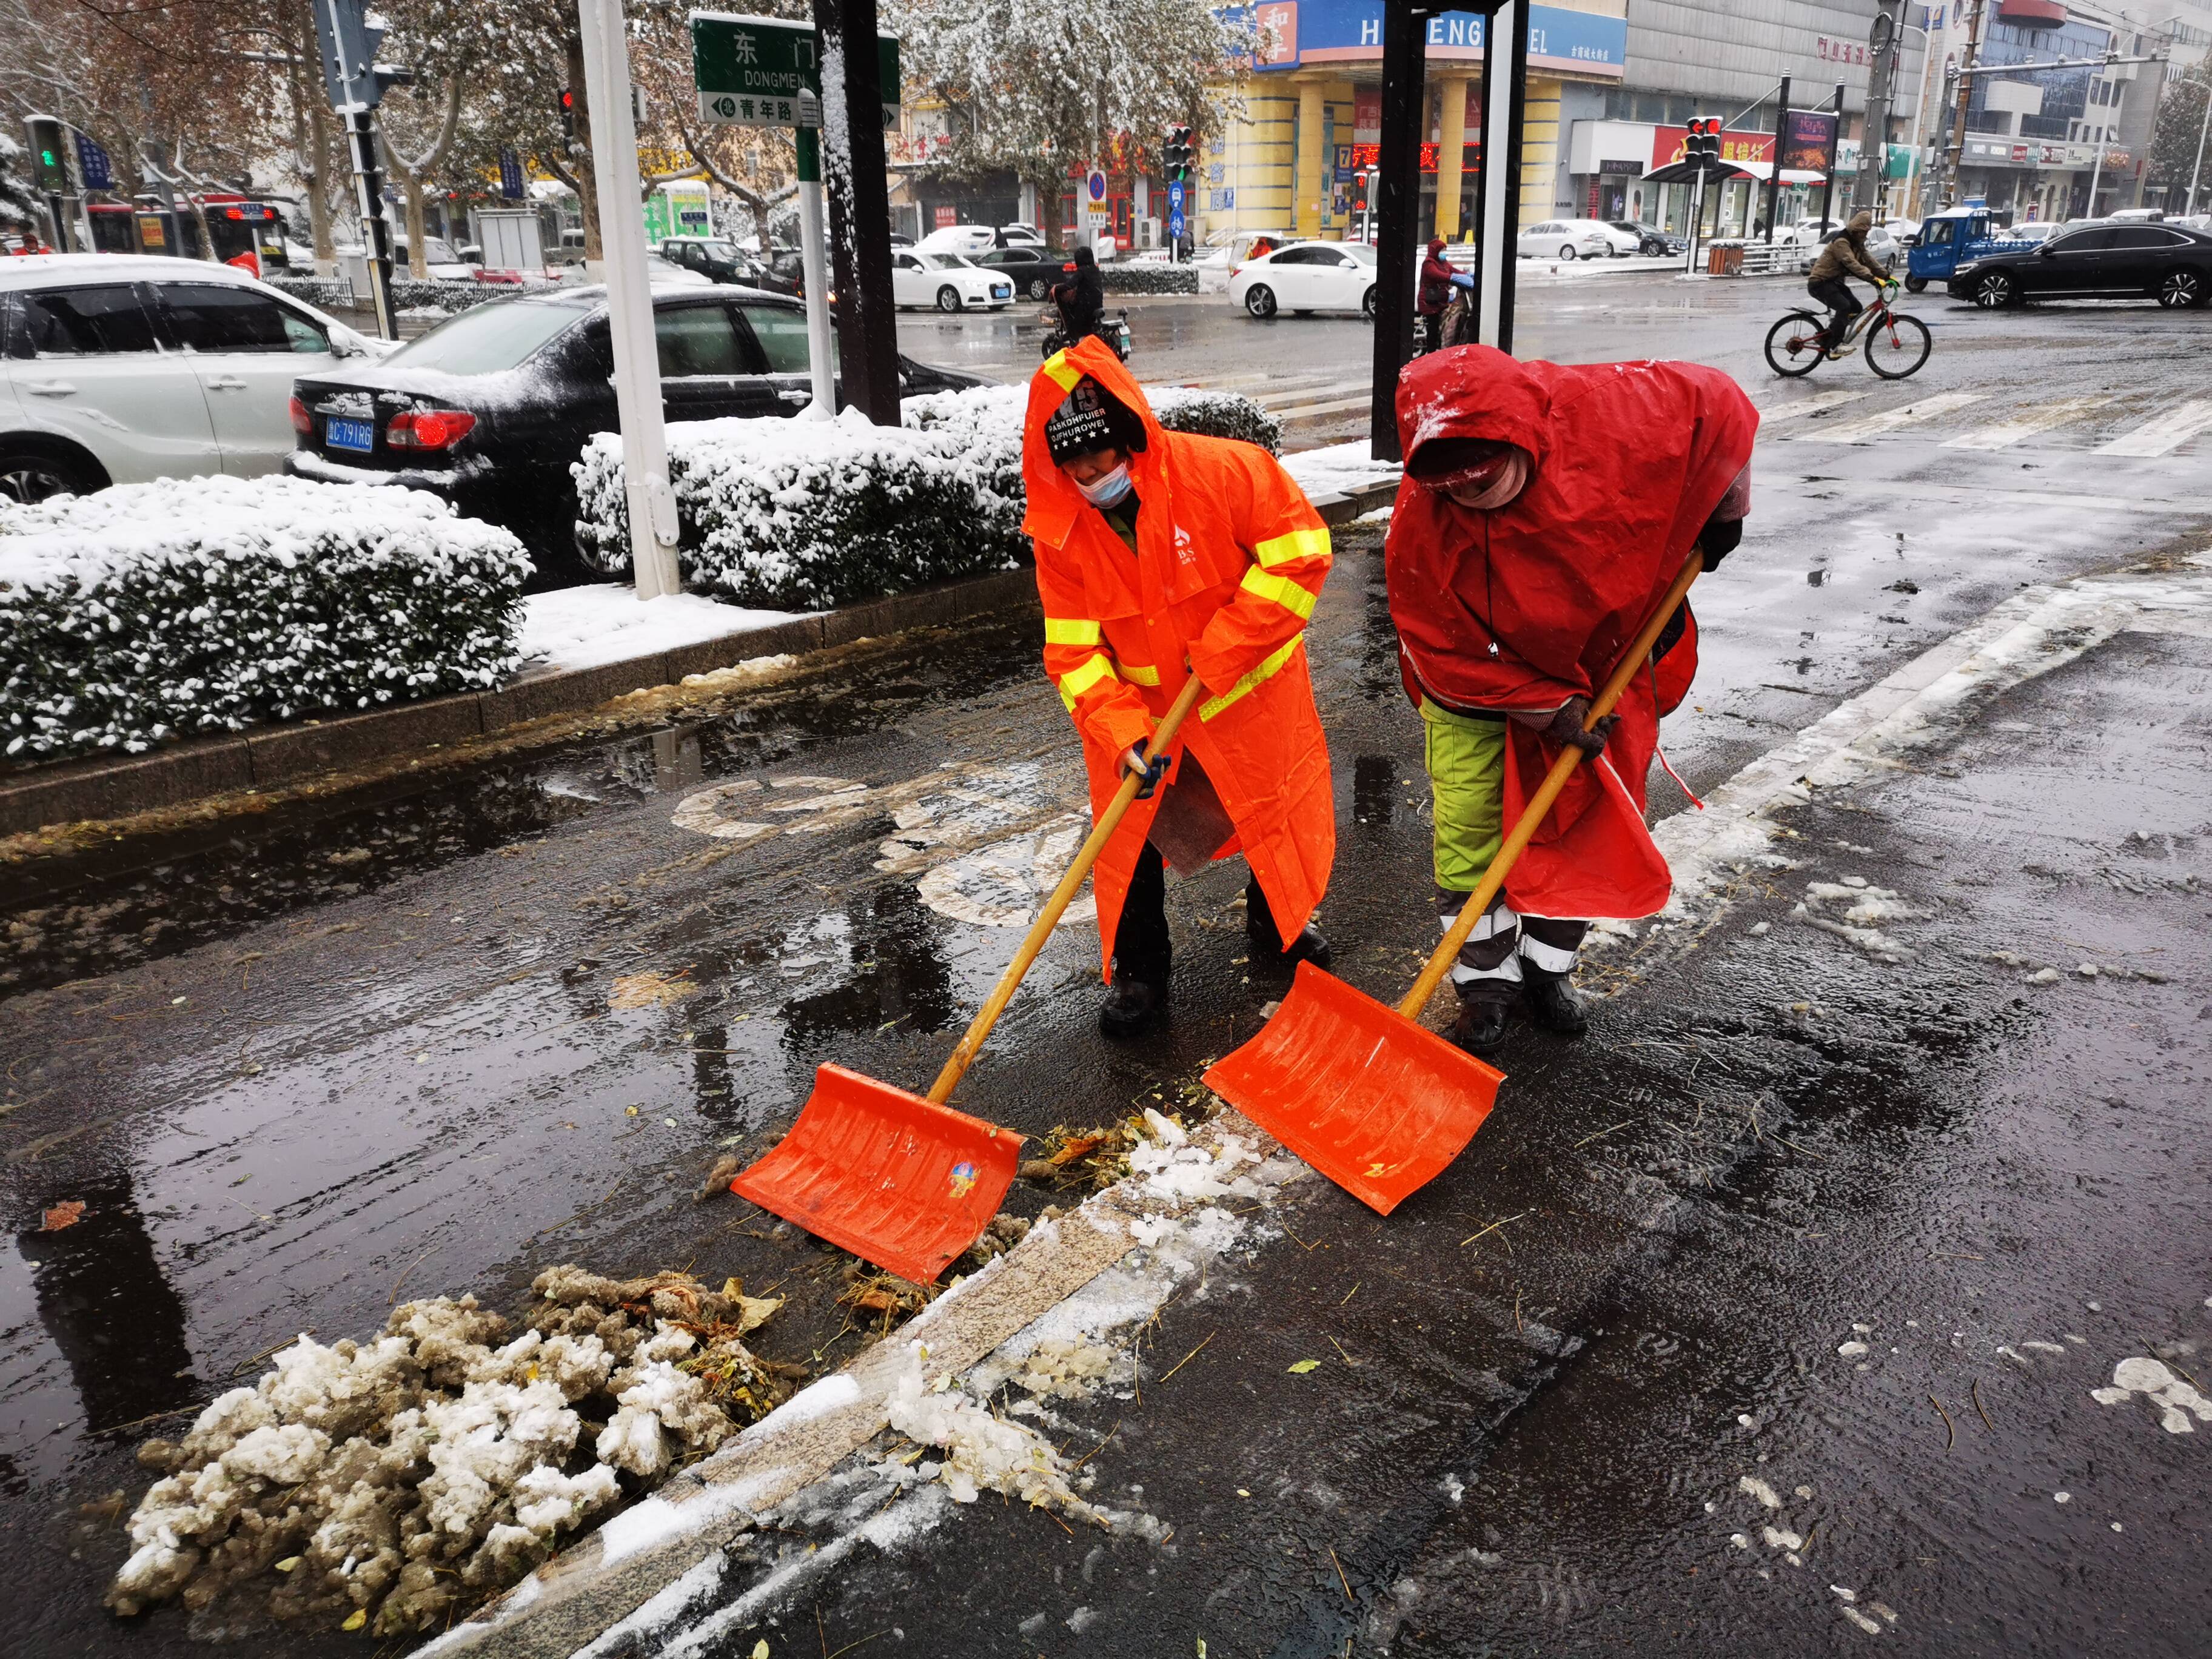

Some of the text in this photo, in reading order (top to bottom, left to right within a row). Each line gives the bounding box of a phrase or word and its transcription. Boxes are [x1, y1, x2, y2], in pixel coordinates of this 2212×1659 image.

[733, 28, 816, 70] 东门
[745, 69, 806, 89] DONGMEN
[740, 98, 792, 121] 青年路
